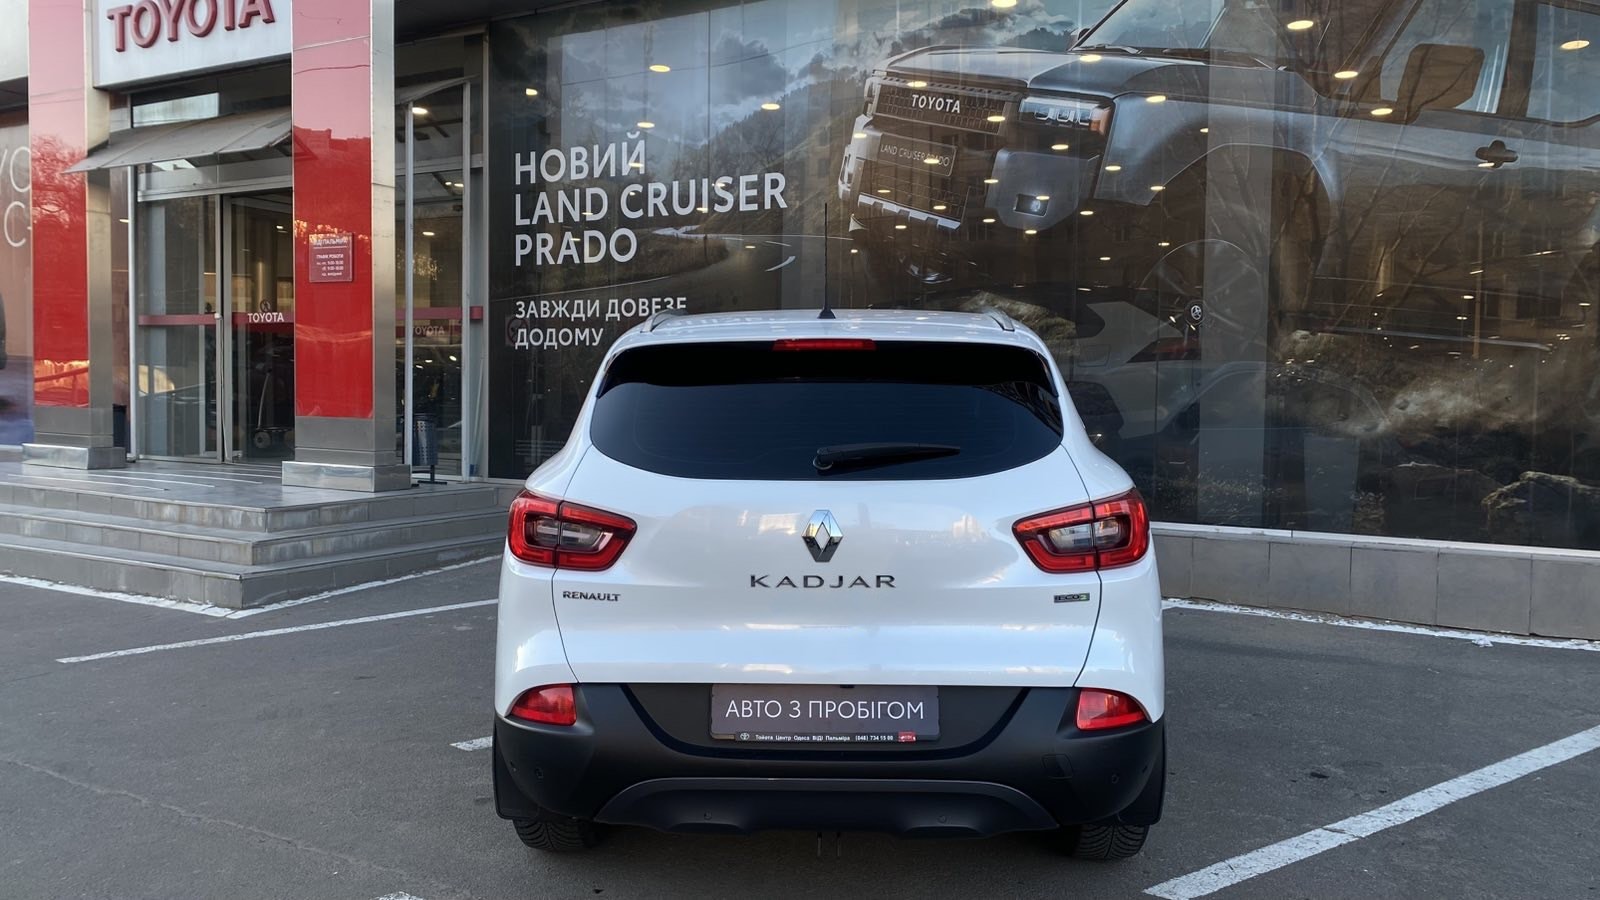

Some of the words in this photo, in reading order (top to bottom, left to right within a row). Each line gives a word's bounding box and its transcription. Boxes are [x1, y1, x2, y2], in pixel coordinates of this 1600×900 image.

[911, 94, 960, 114] TOYOTA
[515, 130, 646, 186] НОВИЙ
[880, 144, 898, 156] LAND
[515, 187, 608, 226] LAND
[620, 172, 788, 219] CRUISER
[515, 227, 638, 266] PRADO
[247, 312, 285, 323] TOYOTA
[515, 299, 600, 321] ЗАВЖДИ
[605, 297, 687, 321] ДОВЕЗЕ
[515, 327, 604, 350] ДОДОМУ
[750, 574, 896, 588] KADJAR
[562, 590, 622, 602] RENAULT
[725, 700, 782, 718] АВТО
[788, 700, 801, 718] З
[808, 700, 924, 719] ПРОБІГОМ
